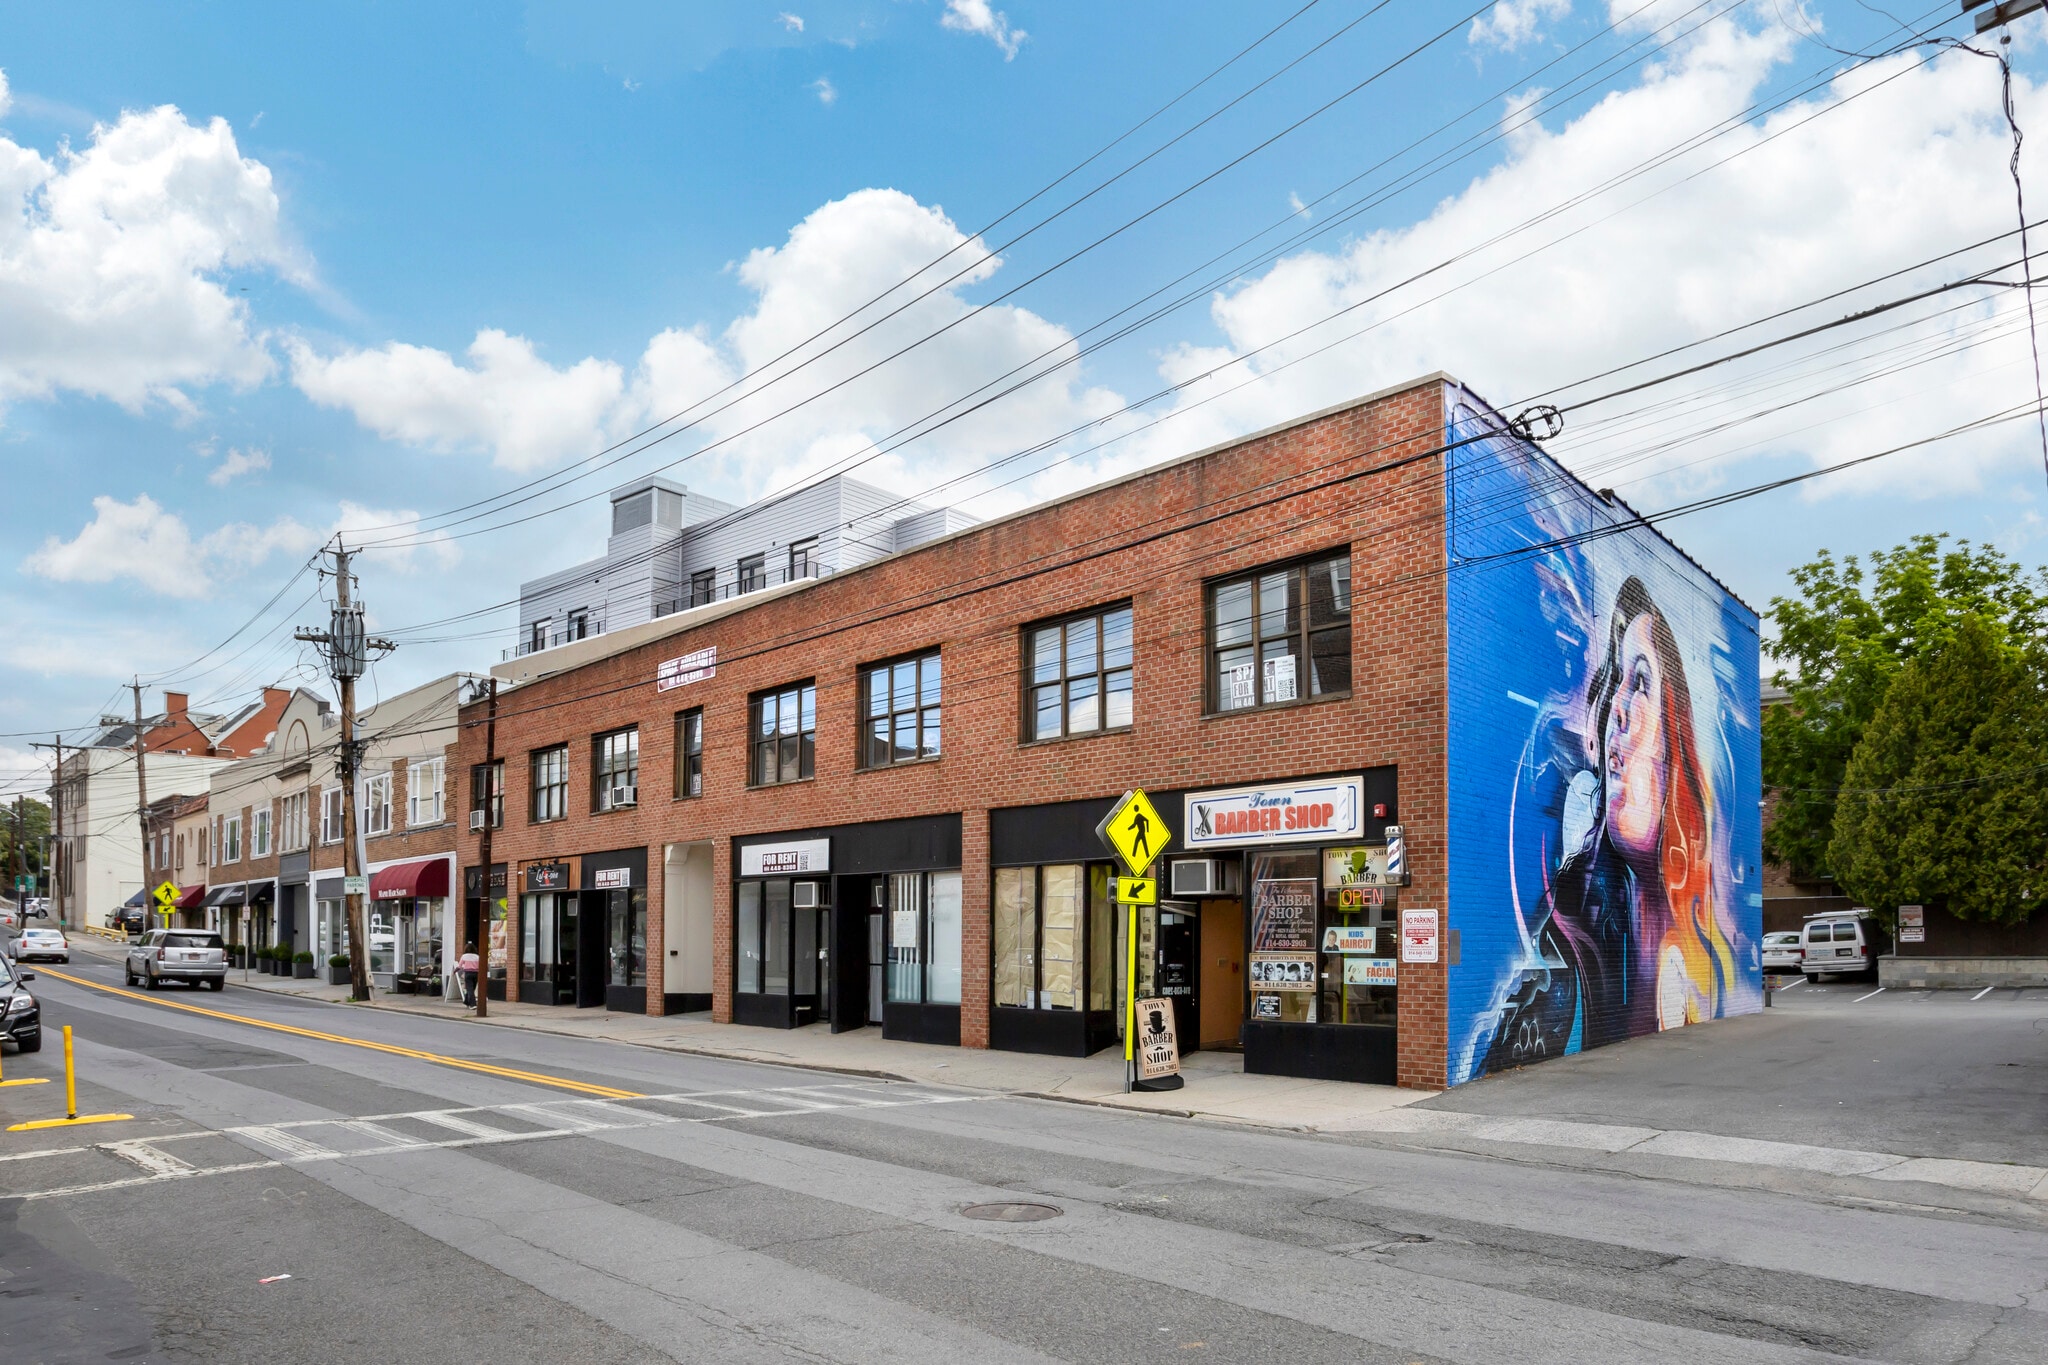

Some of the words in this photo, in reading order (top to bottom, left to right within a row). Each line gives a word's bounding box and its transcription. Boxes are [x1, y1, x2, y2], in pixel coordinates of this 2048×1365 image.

[1233, 682, 1249, 697] FOR
[1248, 792, 1292, 808] Town
[1215, 808, 1281, 835] BARBER
[1285, 803, 1334, 829] SHOP
[763, 854, 777, 865] FOR
[777, 852, 797, 865] RENT
[1327, 851, 1349, 859] TOWN
[597, 872, 607, 881] FOR
[607, 871, 620, 881] RENT
[1340, 873, 1378, 885] BARBER
[1261, 894, 1313, 906] BARBER
[1341, 888, 1384, 905] OPEN
[1268, 907, 1304, 919] SHOP
[1414, 916, 1435, 924] PARKING
[1339, 939, 1373, 949] HAIRCUT
[1366, 967, 1396, 978] FACIAL
[1143, 1001, 1165, 1011] TOWN
[1142, 1032, 1173, 1047] BARBER
[1146, 1050, 1173, 1064] SHOP
